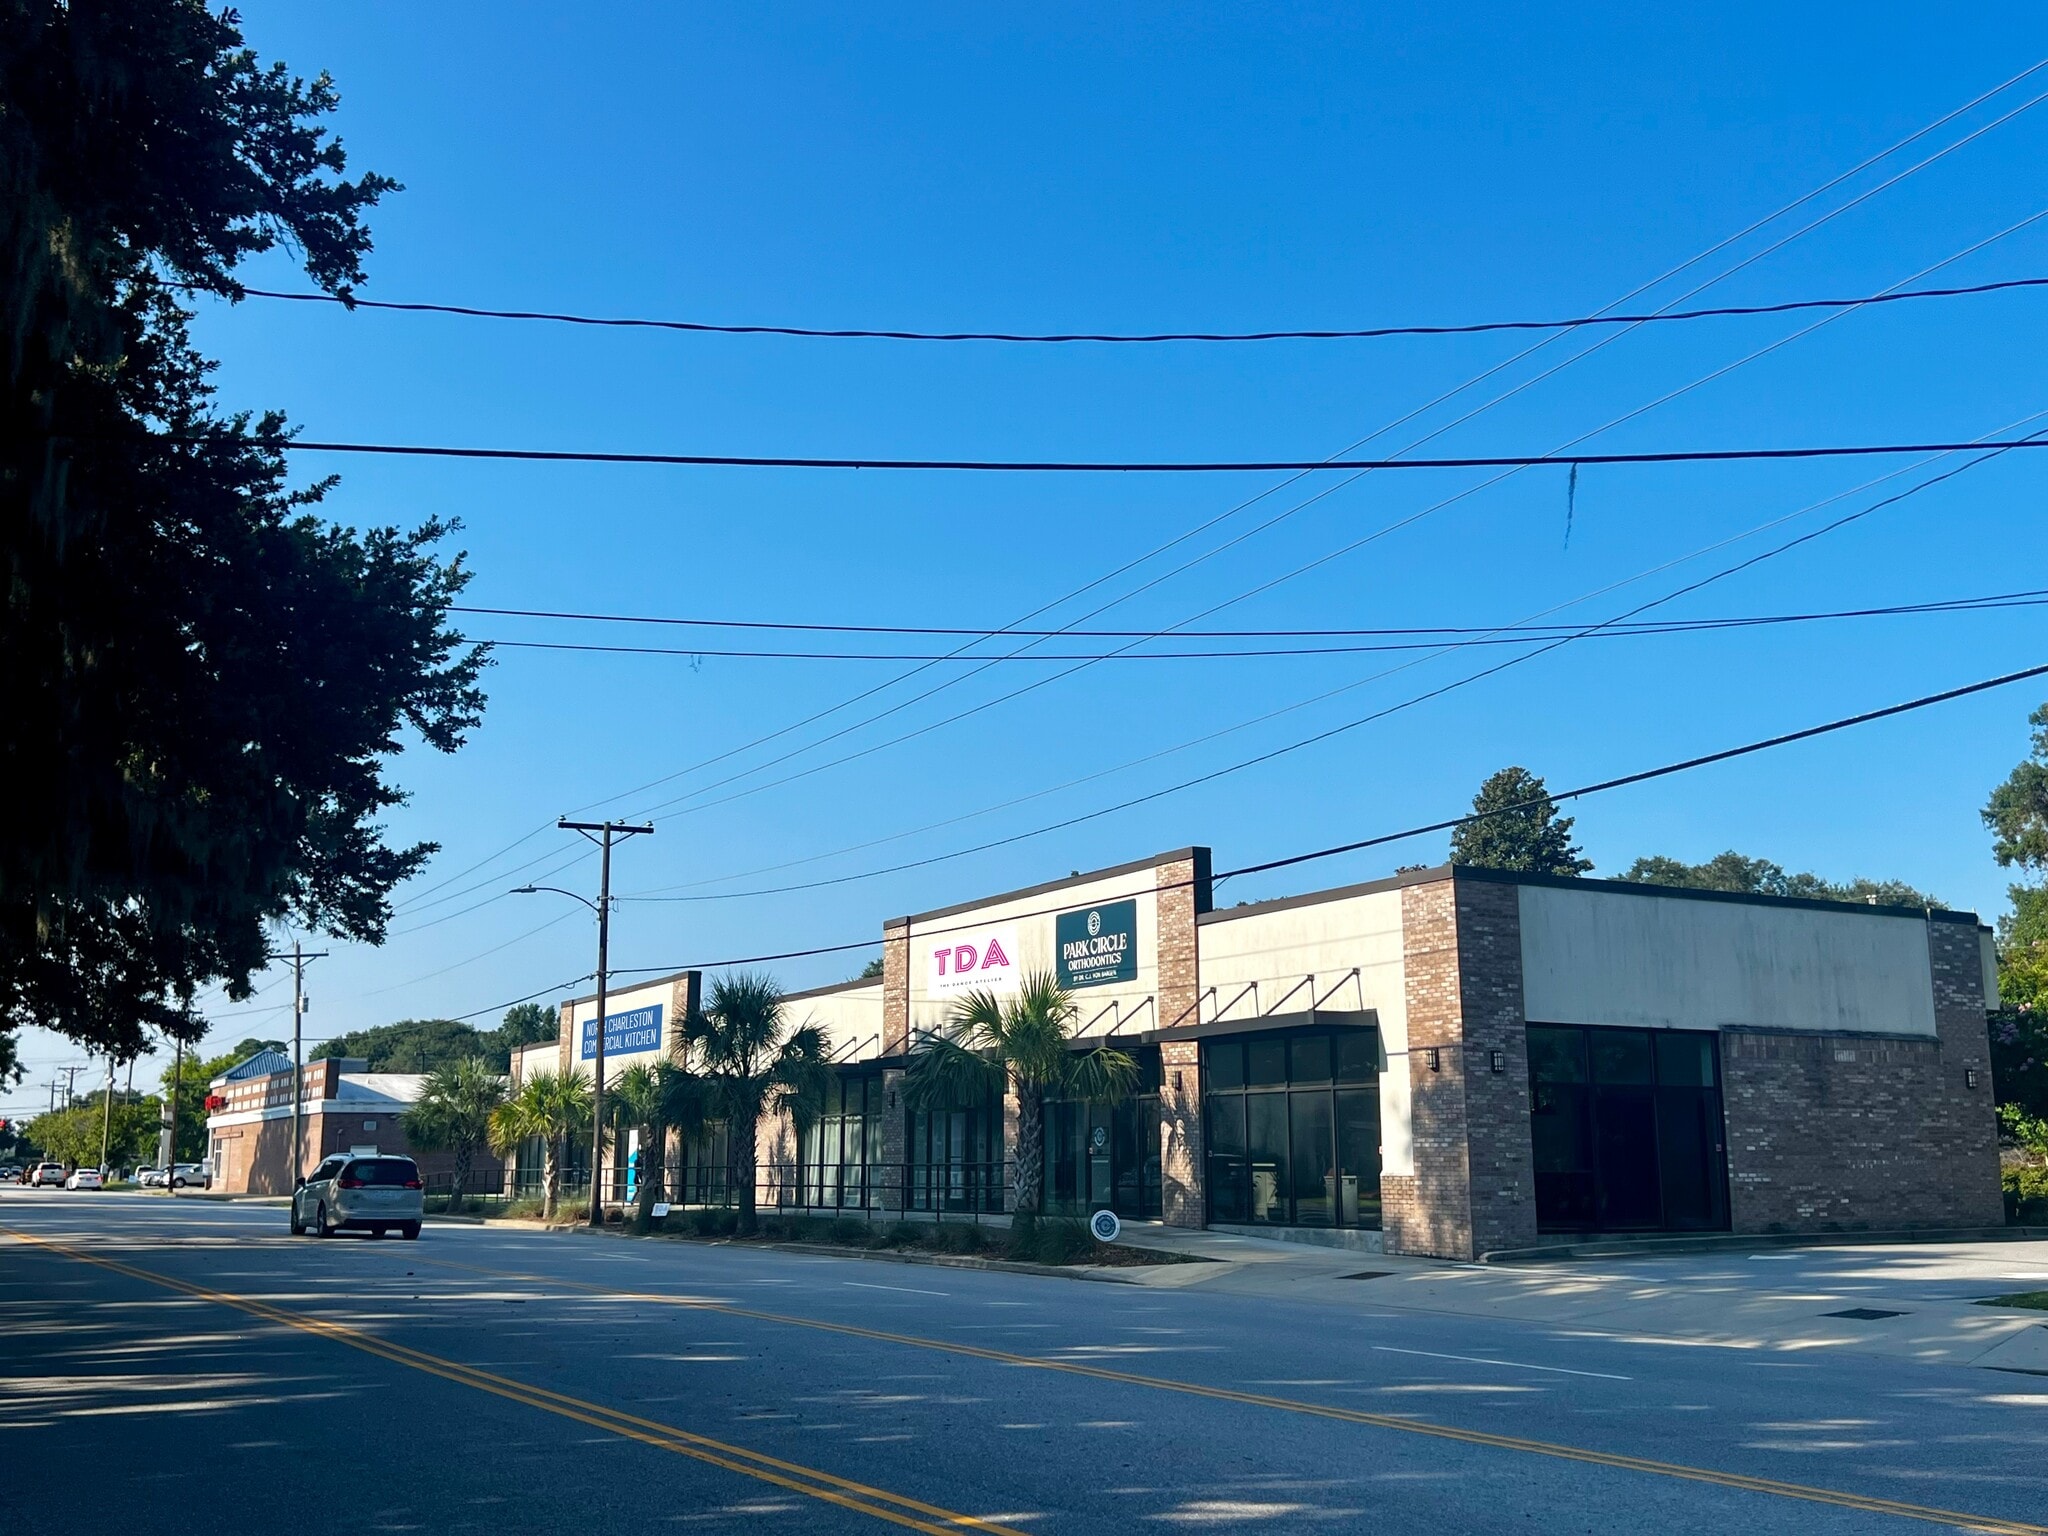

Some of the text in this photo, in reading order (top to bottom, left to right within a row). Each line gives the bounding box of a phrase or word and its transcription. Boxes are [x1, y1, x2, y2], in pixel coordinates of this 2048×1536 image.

[934, 938, 1010, 976] TDA
[1063, 932, 1127, 960] PARK CIRCLE
[1068, 952, 1122, 972] ORTHODONTICS
[586, 1009, 654, 1038] NORH CHARLESTON
[584, 1028, 657, 1054] COMERCIAL KITCHEN
